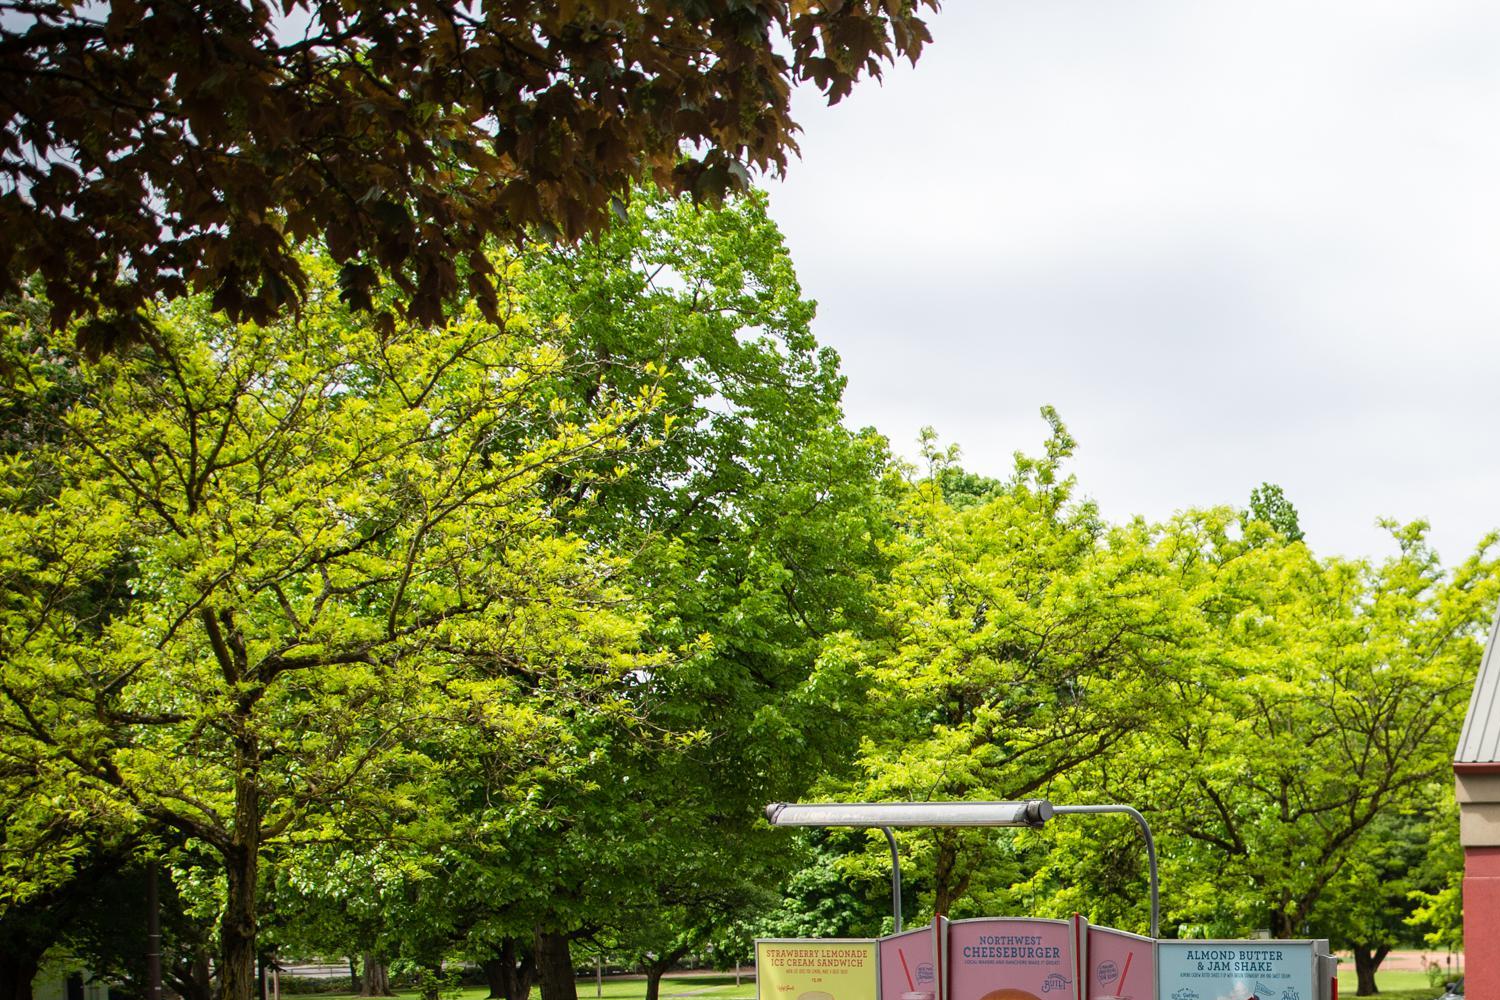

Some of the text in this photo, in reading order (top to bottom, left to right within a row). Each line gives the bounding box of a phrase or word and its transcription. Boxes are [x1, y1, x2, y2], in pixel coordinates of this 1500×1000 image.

[979, 936, 1042, 945] NORTHWEST
[766, 949, 868, 959] STRAWBERRY LEMONADE
[963, 946, 1060, 958] CHEESEBURGER
[1186, 950, 1283, 960] ALMOND BUTTER
[771, 959, 863, 968] ICE CREAM SANDWICH
[1197, 961, 1273, 971] & JAM SHAKE
